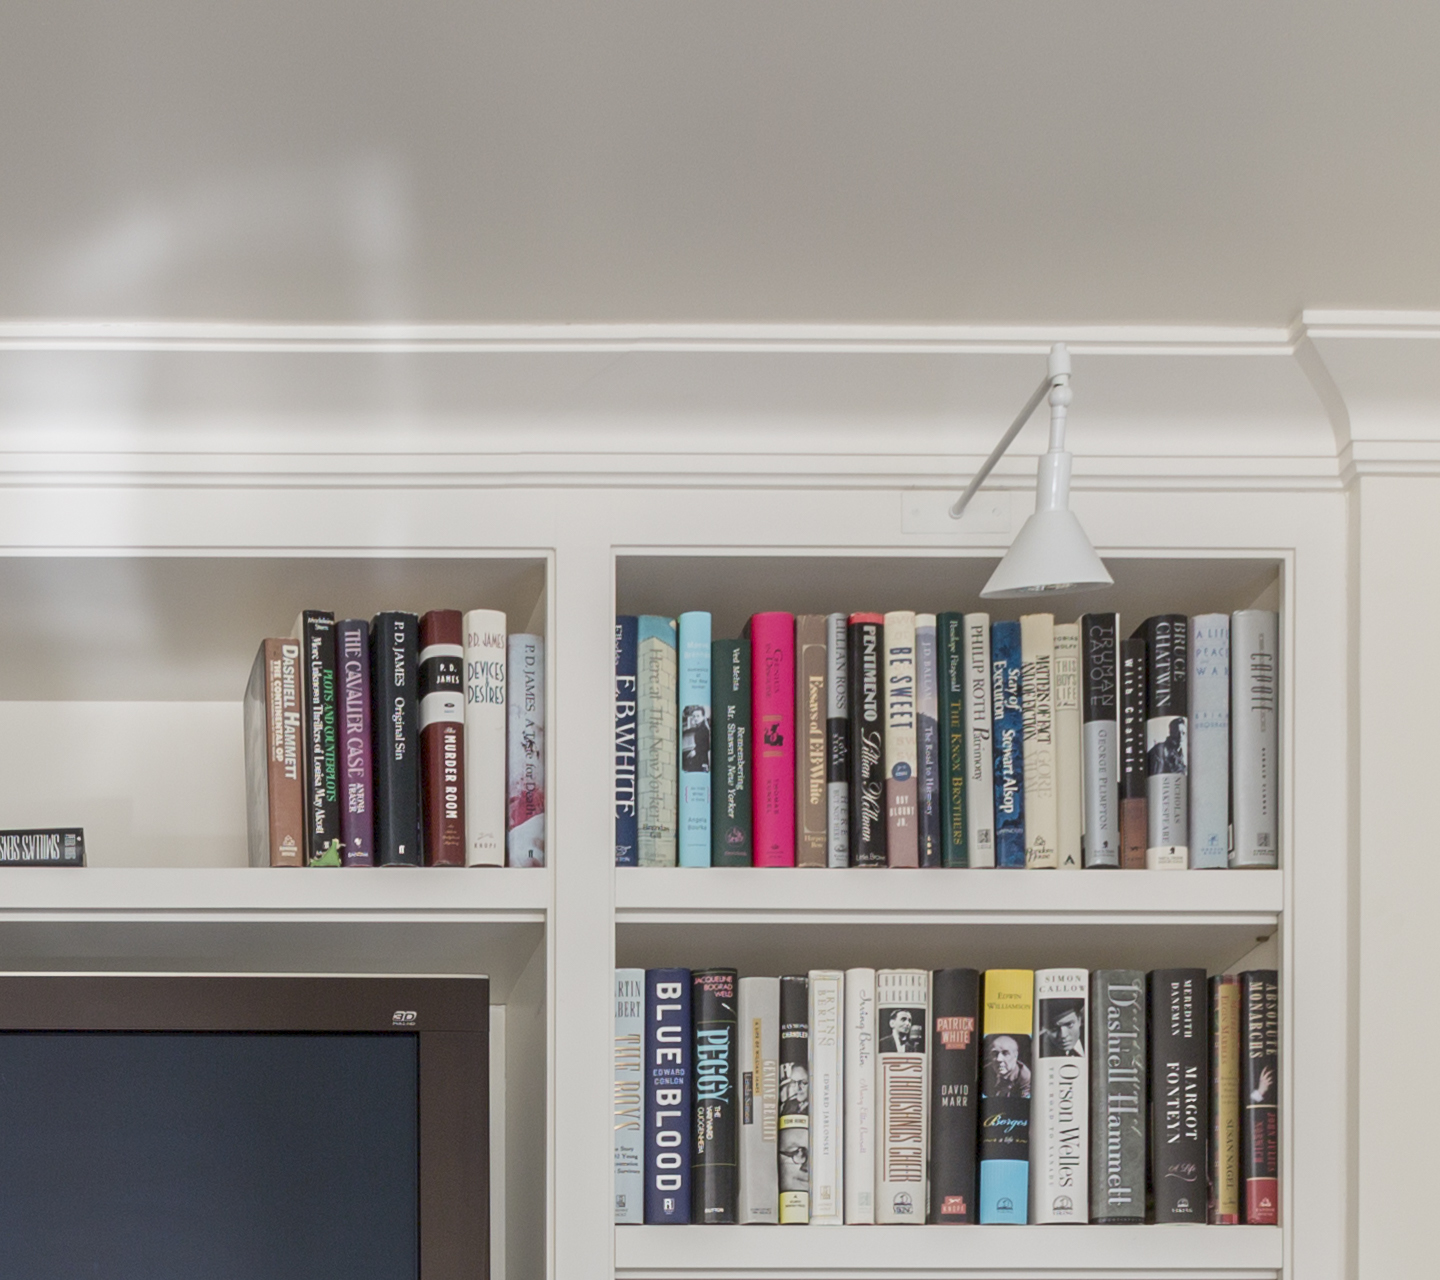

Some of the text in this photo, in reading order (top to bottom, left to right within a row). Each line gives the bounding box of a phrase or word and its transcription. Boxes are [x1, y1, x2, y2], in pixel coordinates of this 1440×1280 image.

[283, 644, 299, 780] DASHIELL HAMMETT
[863, 625, 876, 721] PENTIMENTO
[890, 647, 912, 728] BE SWEET
[971, 625, 986, 721] PHILIP ROTH
[1155, 622, 1171, 707] CHATWIN
[444, 735, 459, 818] MURDER ROOM
[951, 699, 963, 845] THE KNOX BROTHERS
[656, 983, 681, 1191] BLUE BLOOD
[697, 1026, 732, 1104] PEGGY
[1108, 983, 1139, 1206] Dashiell Hammett
[1166, 1062, 1180, 1144] FONTEYN
[1185, 1066, 1198, 1141] MARGOT
[1059, 1064, 1080, 1187] Orson Welles
